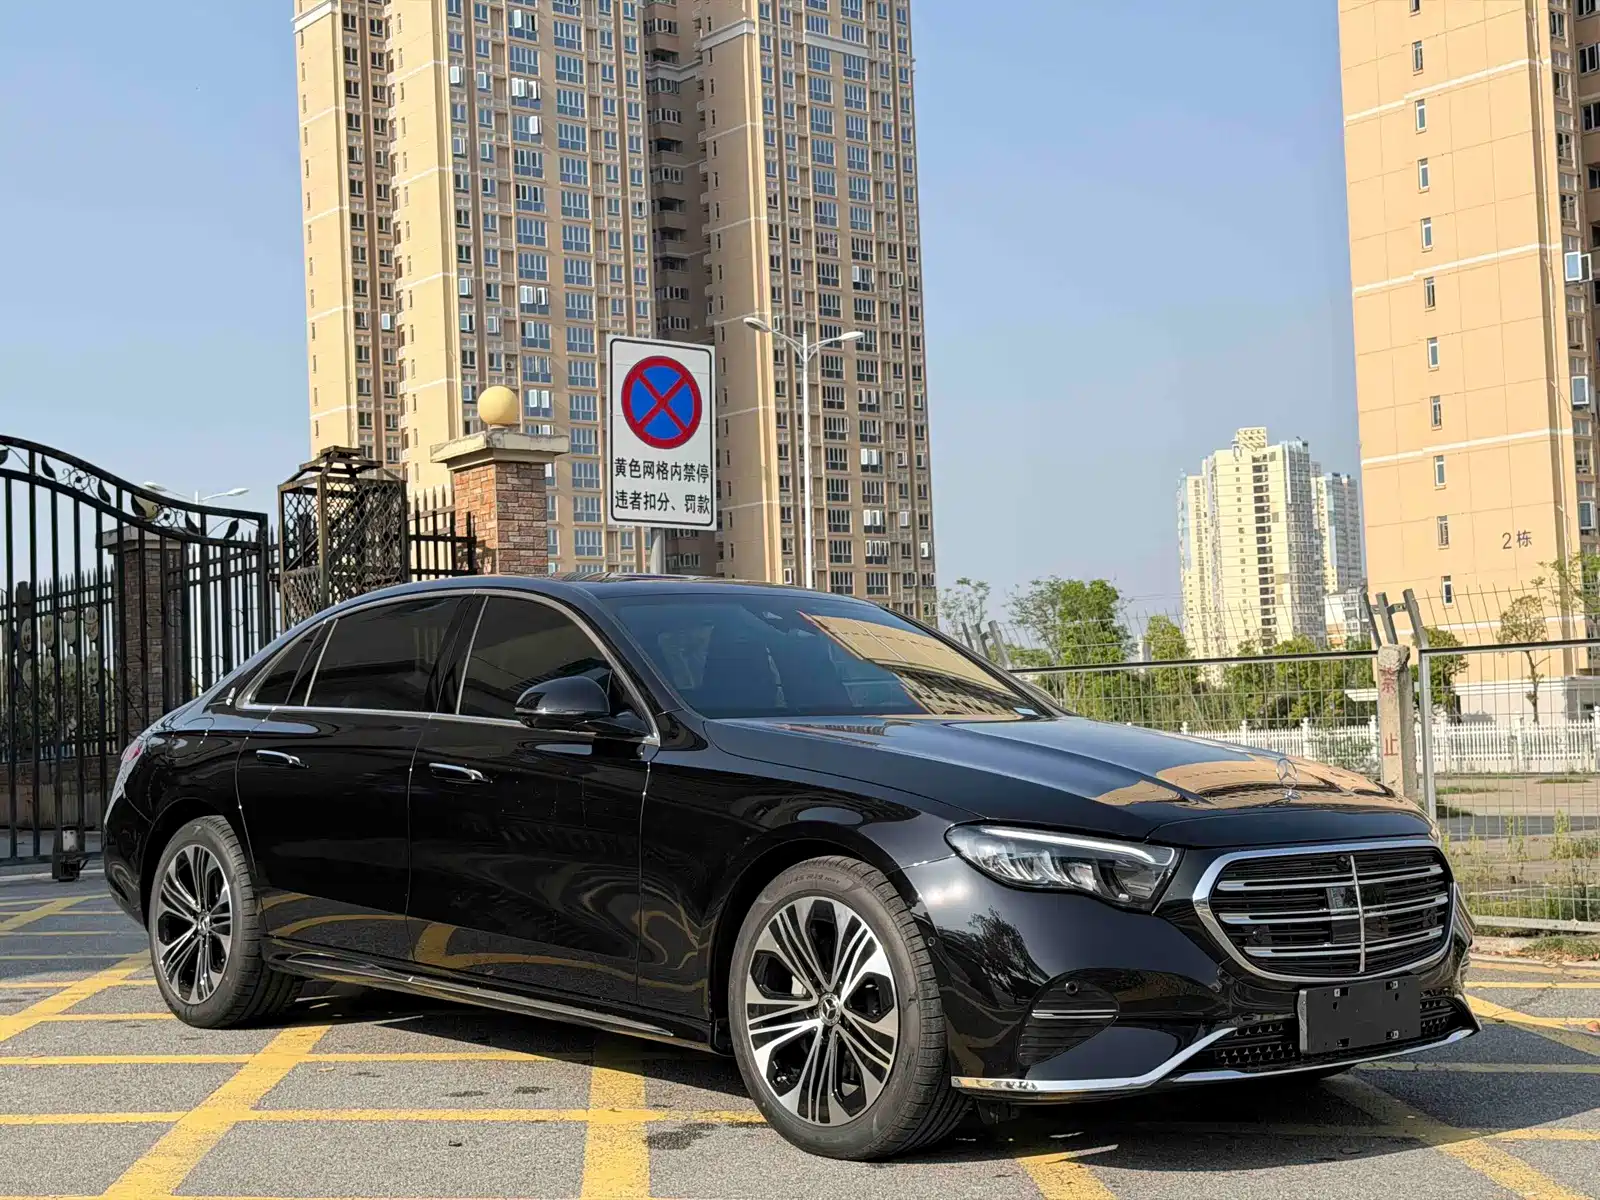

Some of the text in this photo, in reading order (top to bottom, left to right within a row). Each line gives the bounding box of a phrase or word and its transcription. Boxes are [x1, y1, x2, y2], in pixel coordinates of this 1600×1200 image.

[614, 457, 709, 483] 黄色网格内禁停
[614, 490, 710, 514] 违者扣分、罚款
[1502, 530, 1532, 549] 2栋
